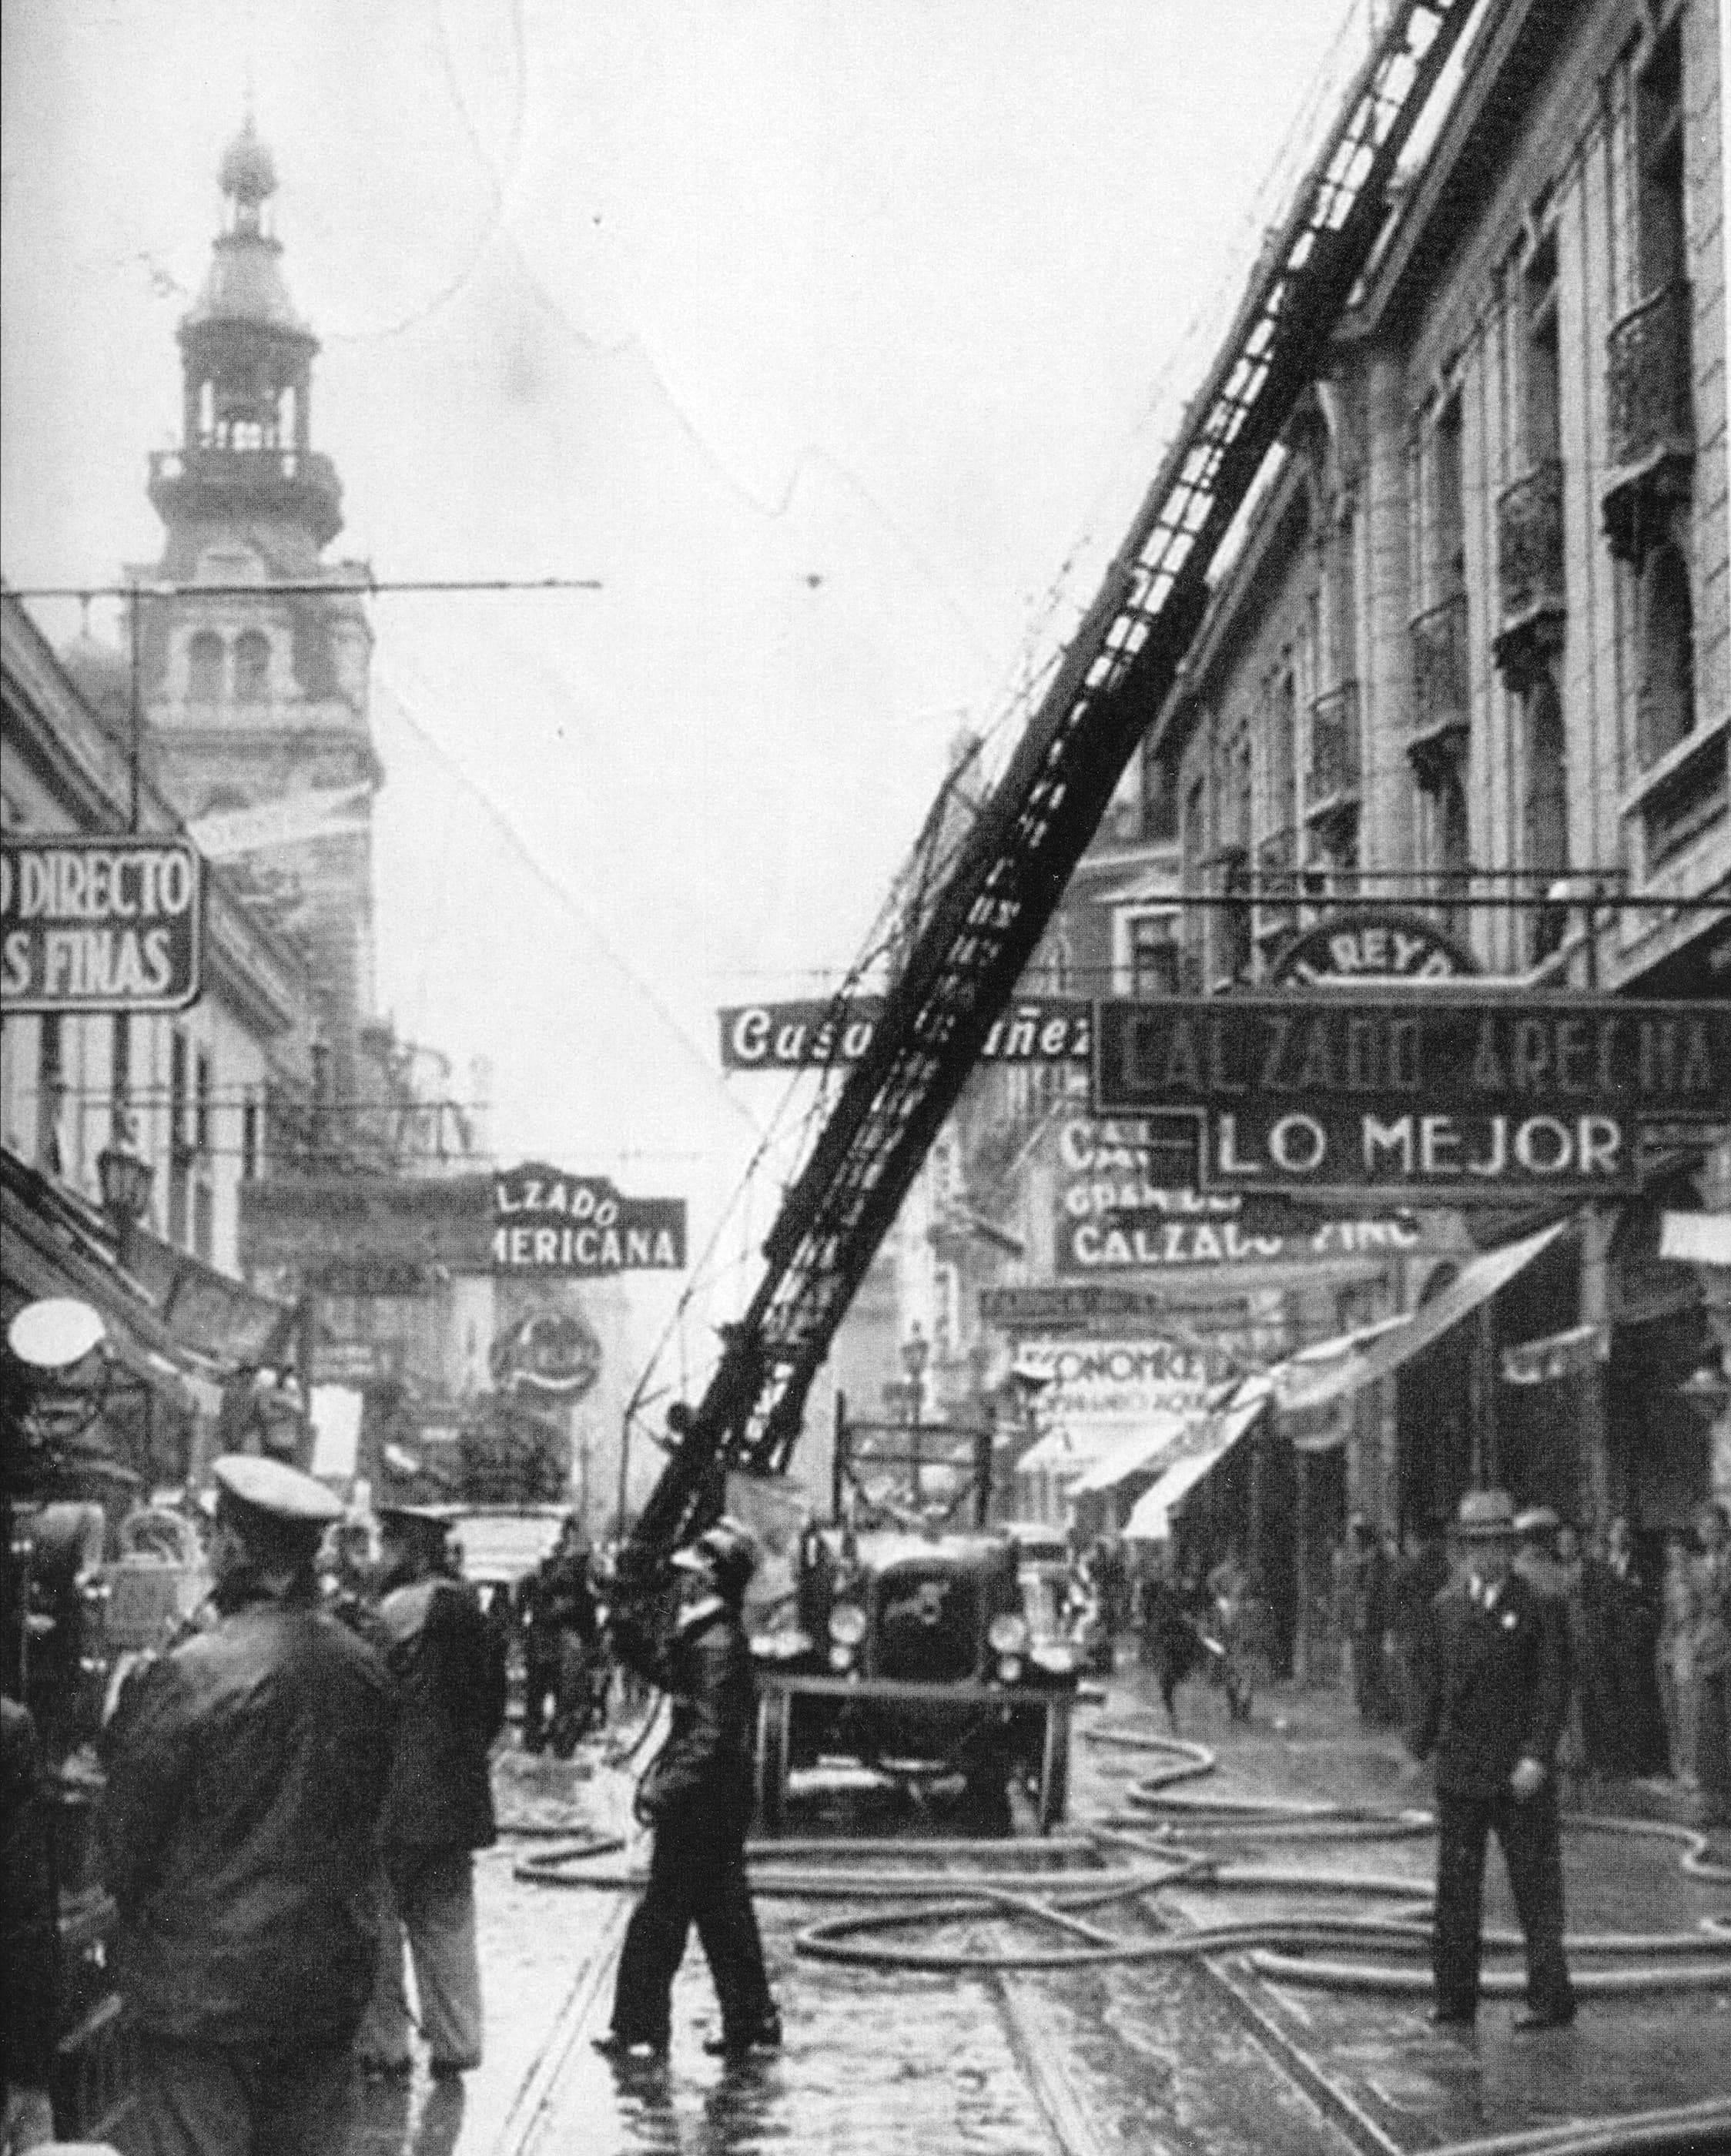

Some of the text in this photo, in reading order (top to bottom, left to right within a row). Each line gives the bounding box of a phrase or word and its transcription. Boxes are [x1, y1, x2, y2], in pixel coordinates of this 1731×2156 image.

[19, 850, 191, 918] DIRECTO
[44, 929, 171, 993] FINAS
[734, 1009, 873, 1060] Casa
[1218, 1113, 1621, 1175] LO MEJOR
